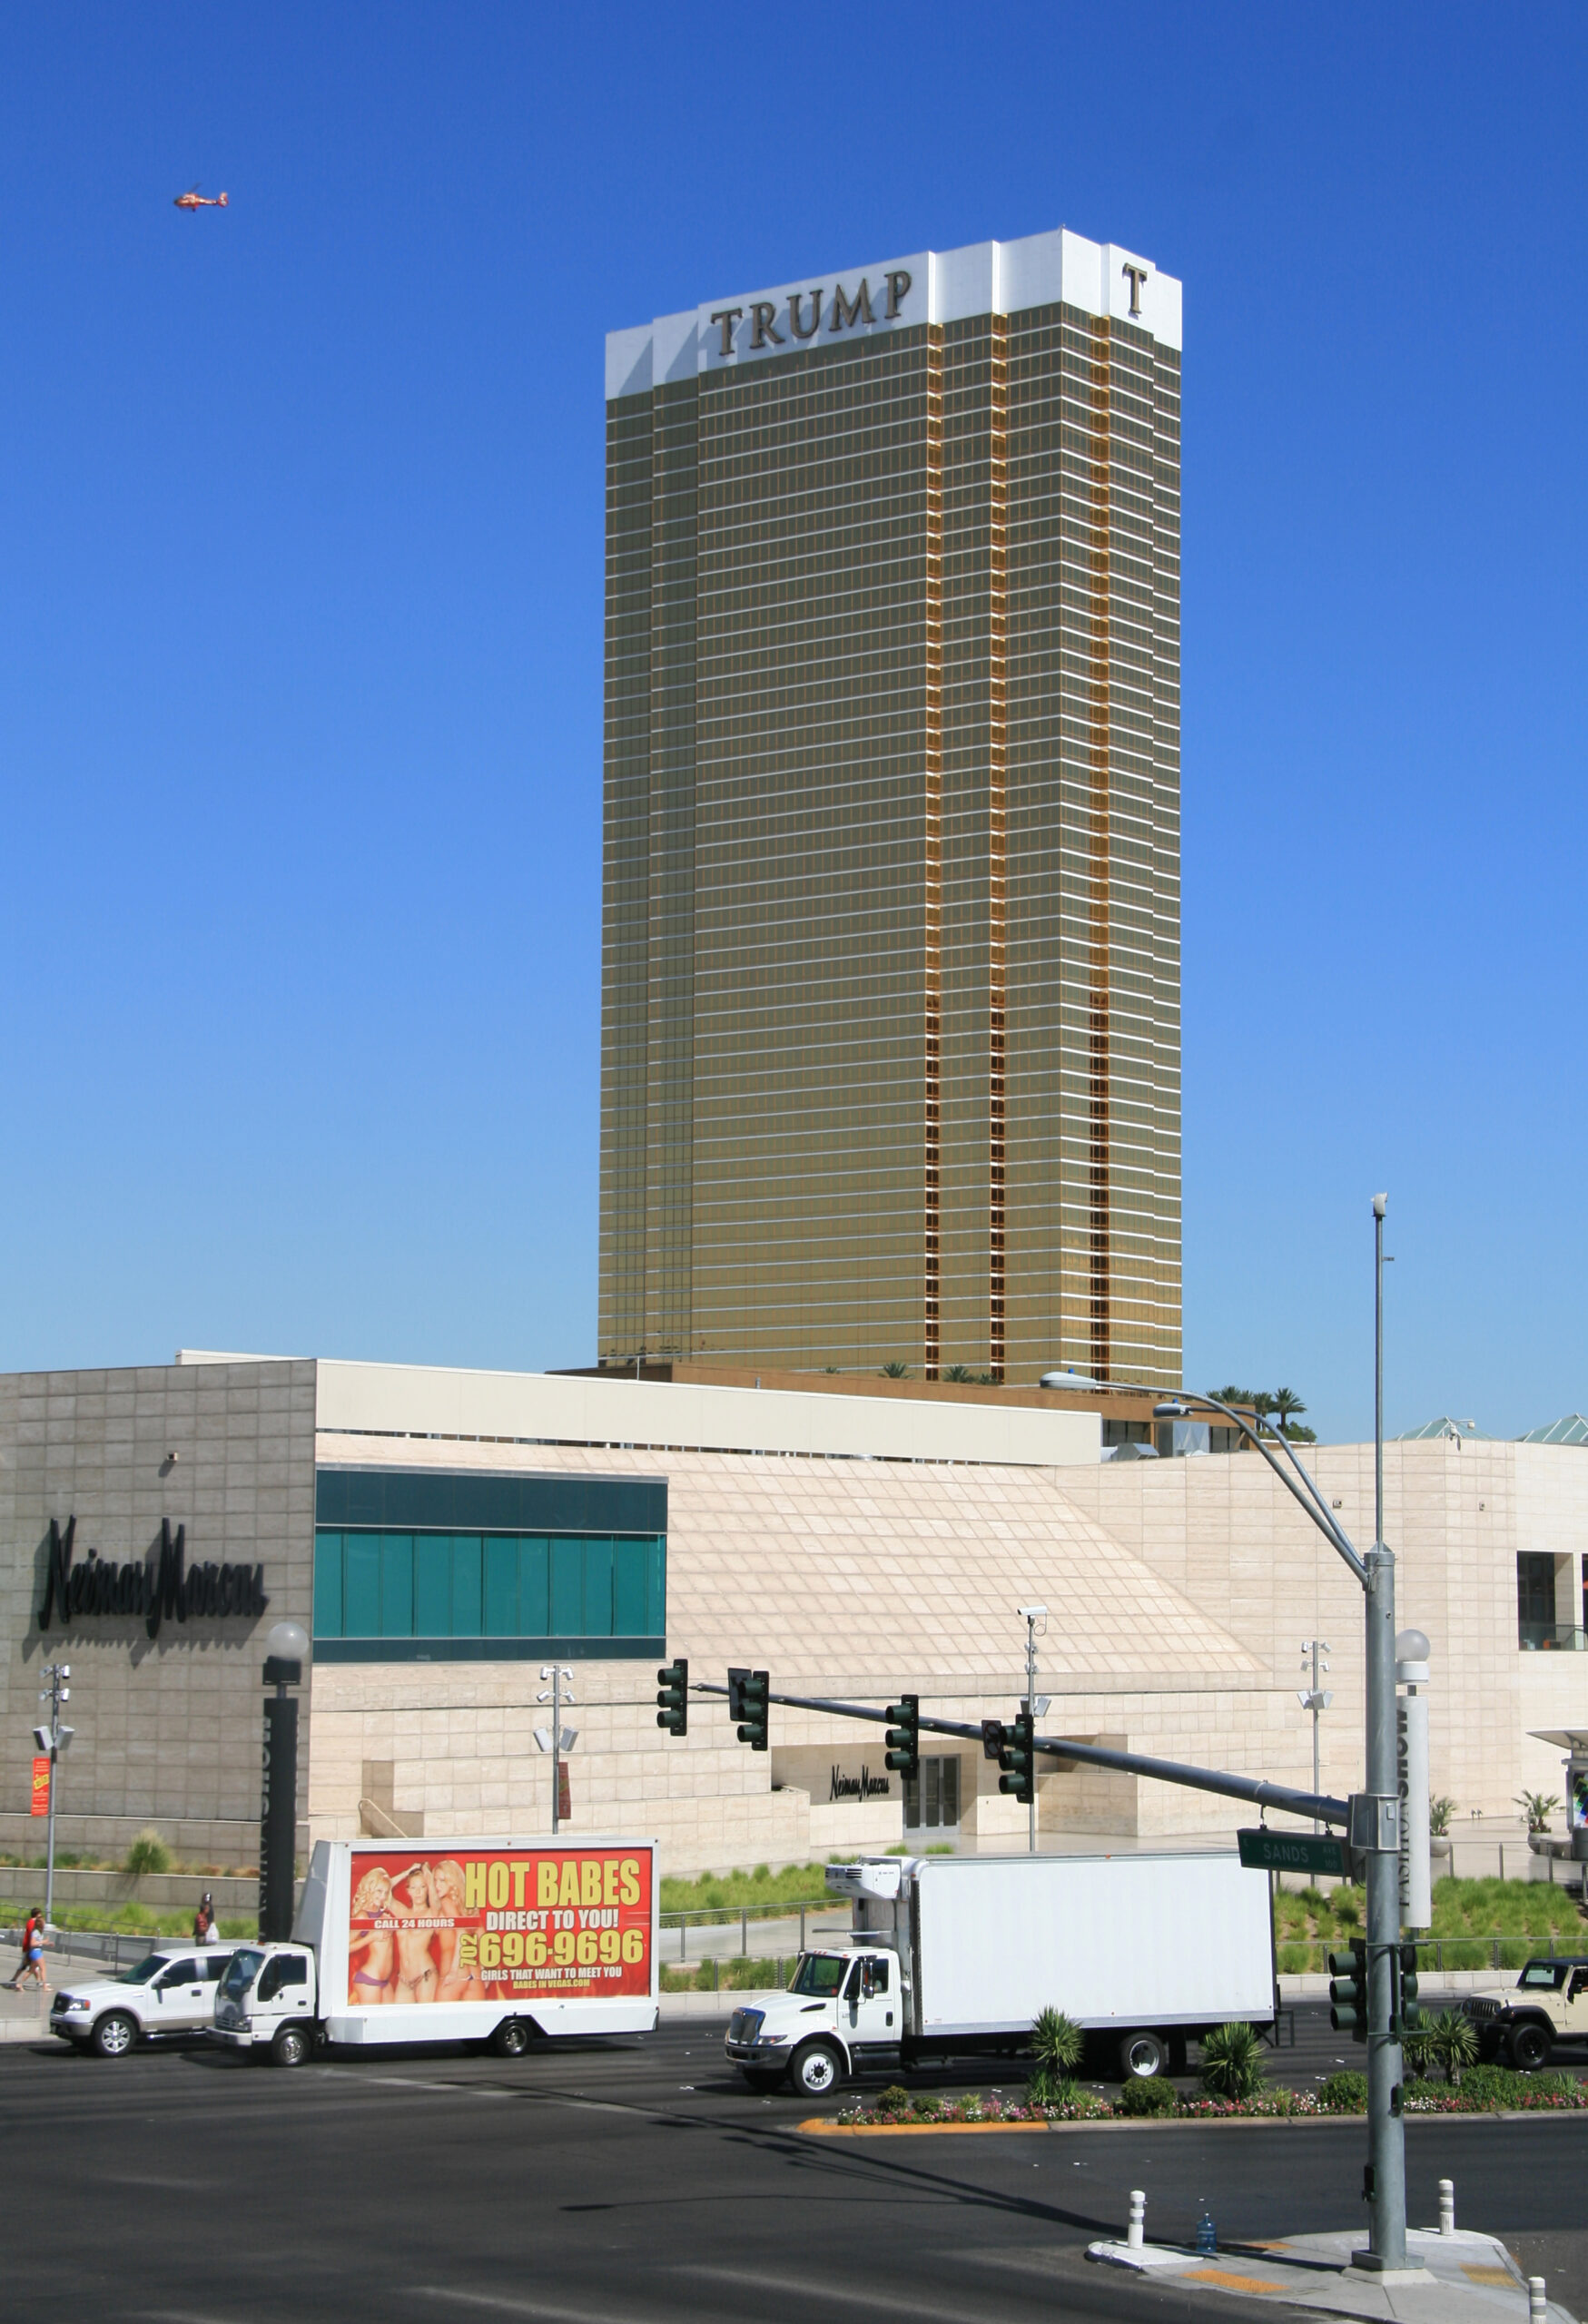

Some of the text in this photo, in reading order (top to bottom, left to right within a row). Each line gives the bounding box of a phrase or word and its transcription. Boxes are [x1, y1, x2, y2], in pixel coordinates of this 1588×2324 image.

[1123, 262, 1148, 314] T
[710, 271, 912, 356] TRUMP
[38, 1514, 270, 1640] Neiman Marcus
[829, 1765, 890, 1803] Neiman Marcus
[1263, 1843, 1308, 1863] SANDS
[1323, 1846, 1336, 1855] AVE
[465, 1858, 641, 1909] HOT BABES
[374, 1918, 455, 1929] CALL 24 HOURS
[486, 1908, 619, 1931] DIRECT TO YOU!
[459, 1933, 478, 1968] 702
[481, 1966, 623, 1981] GIRLS THAT WANT TO MEET YOU
[513, 1979, 590, 1990] BABES IN VEGAS.COM
